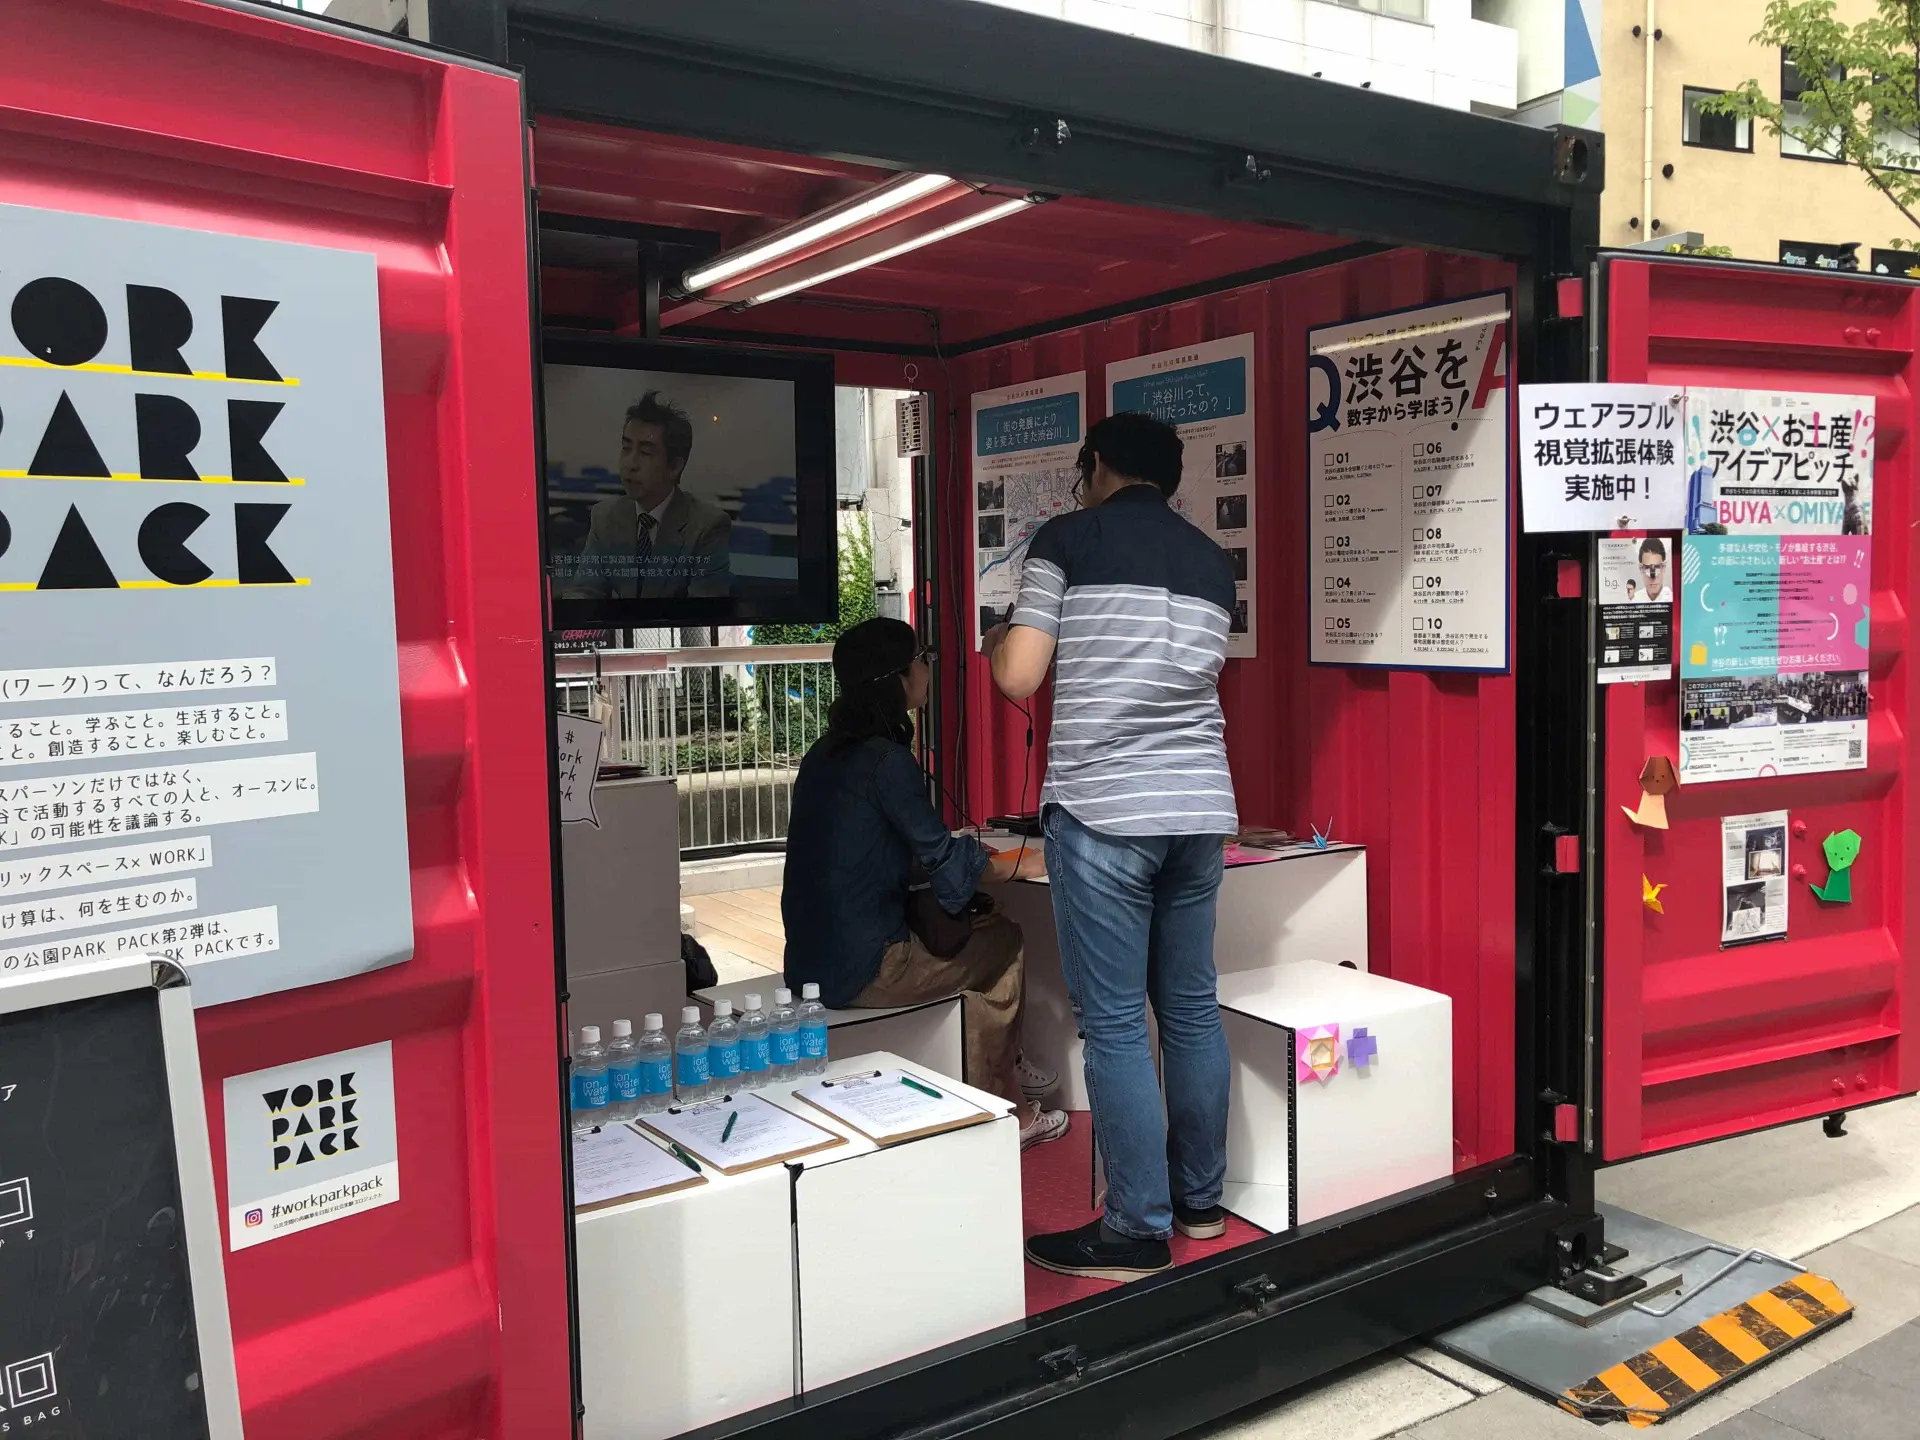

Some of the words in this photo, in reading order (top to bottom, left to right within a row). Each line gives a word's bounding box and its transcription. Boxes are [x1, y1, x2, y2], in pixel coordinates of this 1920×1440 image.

[8, 275, 285, 382] ORK
[1345, 338, 1468, 405] 渋谷を
[1533, 401, 1675, 431] ウェアラブル
[0, 389, 291, 483] ARK
[1426, 442, 1442, 454] 06
[1533, 437, 1675, 467] 視覚拡張体験
[1336, 452, 1349, 464] 01
[1707, 446, 1854, 483] アイデアピッチ
[1426, 485, 1442, 497] 07
[1564, 473, 1651, 502] 実施中！
[1336, 494, 1350, 506] 02
[1712, 500, 1773, 525] BUYA
[1336, 536, 1350, 547] 03
[1426, 527, 1442, 539] 08
[0, 501, 297, 590] ACK
[1336, 577, 1351, 588] 04
[1426, 576, 1441, 588] 09
[1336, 617, 1351, 629] 05
[1427, 618, 1443, 630] 10
[0, 704, 282, 739] ること。学ぶこと。生活すること。
[564, 729, 575, 745] #
[558, 748, 583, 765] ork
[560, 764, 577, 782] rk
[195, 931, 275, 956] PACKです。
[779, 1036, 794, 1046] ion
[692, 1056, 707, 1066] ion
[721, 1048, 737, 1059] ion
[262, 1071, 357, 1114] WORK
[583, 1079, 600, 1089] ion
[272, 1098, 359, 1143] PARK
[273, 1125, 360, 1171] PACK
[271, 1174, 383, 1219] #workparkpack
[23, 1406, 61, 1426] BAG
